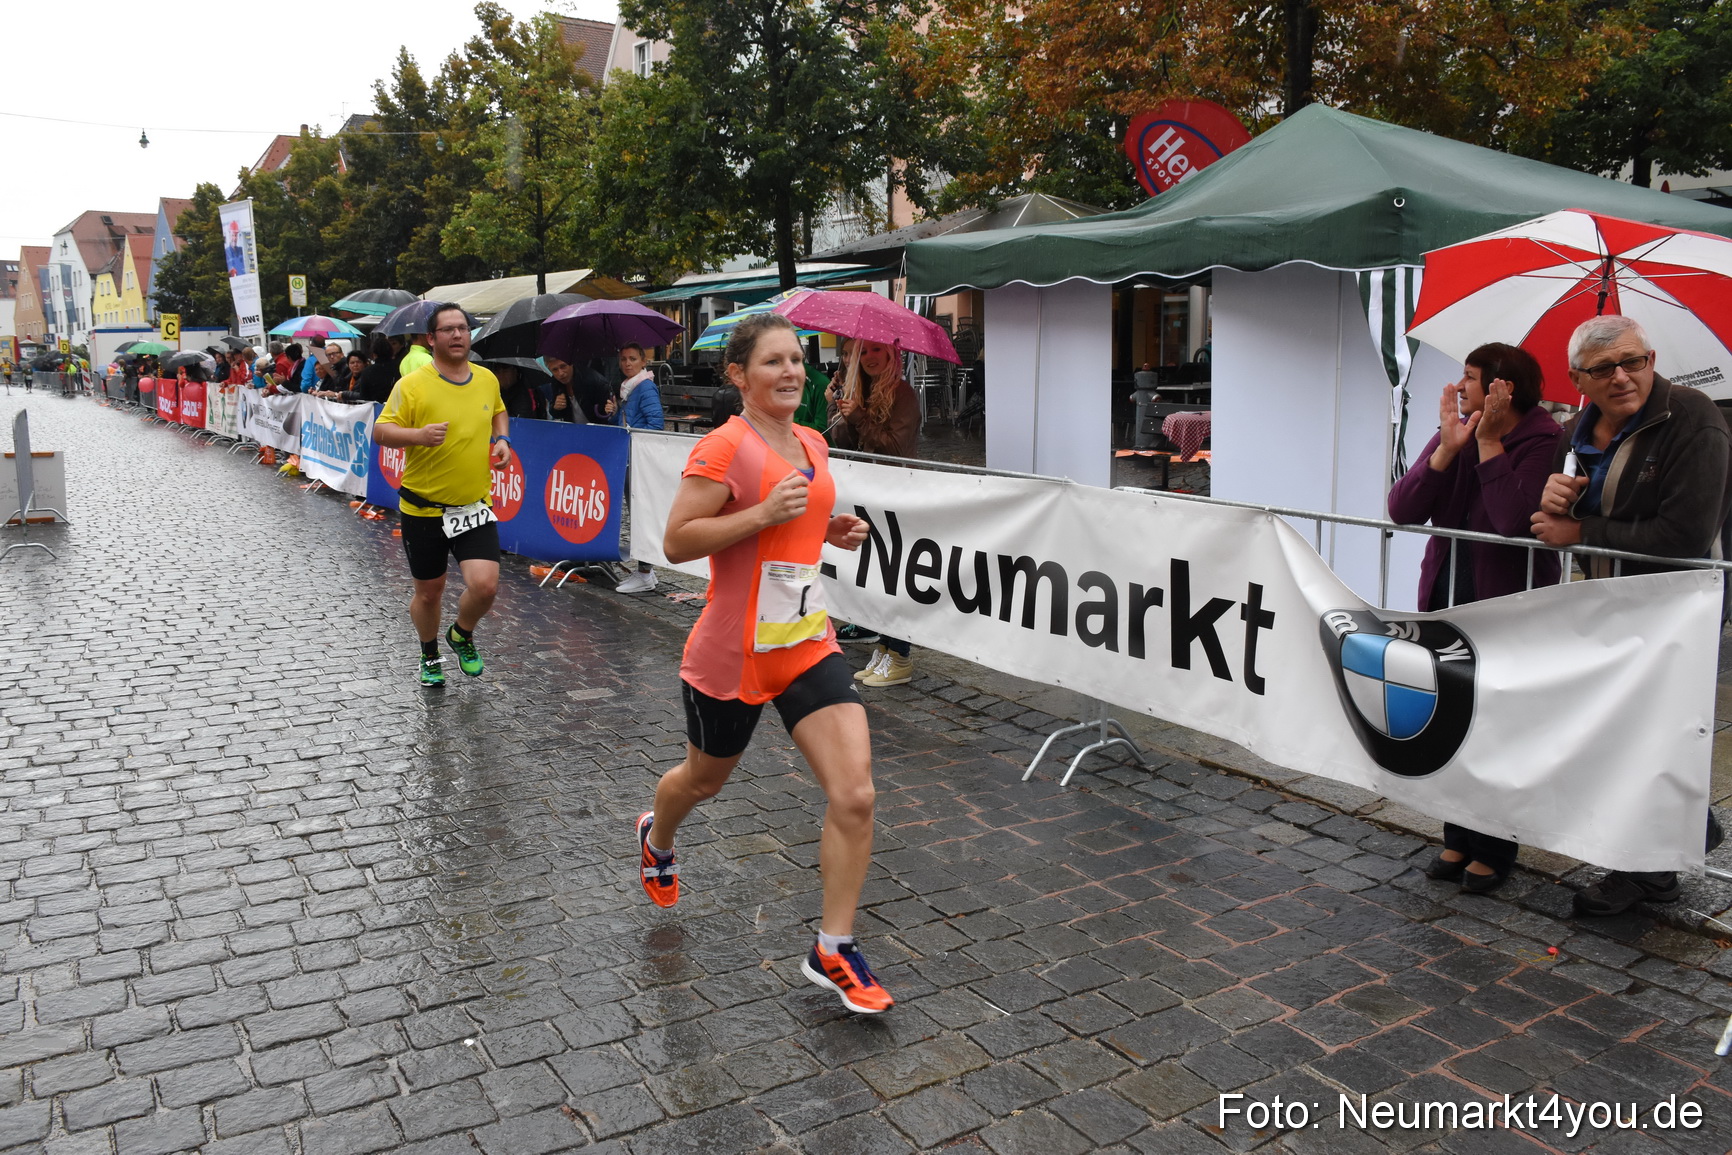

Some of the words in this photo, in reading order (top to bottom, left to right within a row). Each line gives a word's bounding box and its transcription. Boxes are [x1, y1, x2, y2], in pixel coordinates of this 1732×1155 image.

[1146, 157, 1176, 186] SPOR
[165, 321, 176, 336] C
[62, 343, 68, 351] D
[549, 469, 605, 527] Hervis
[449, 508, 490, 533] 2472
[552, 514, 579, 530] SPORTS
[854, 504, 1276, 696] Neumarkt
